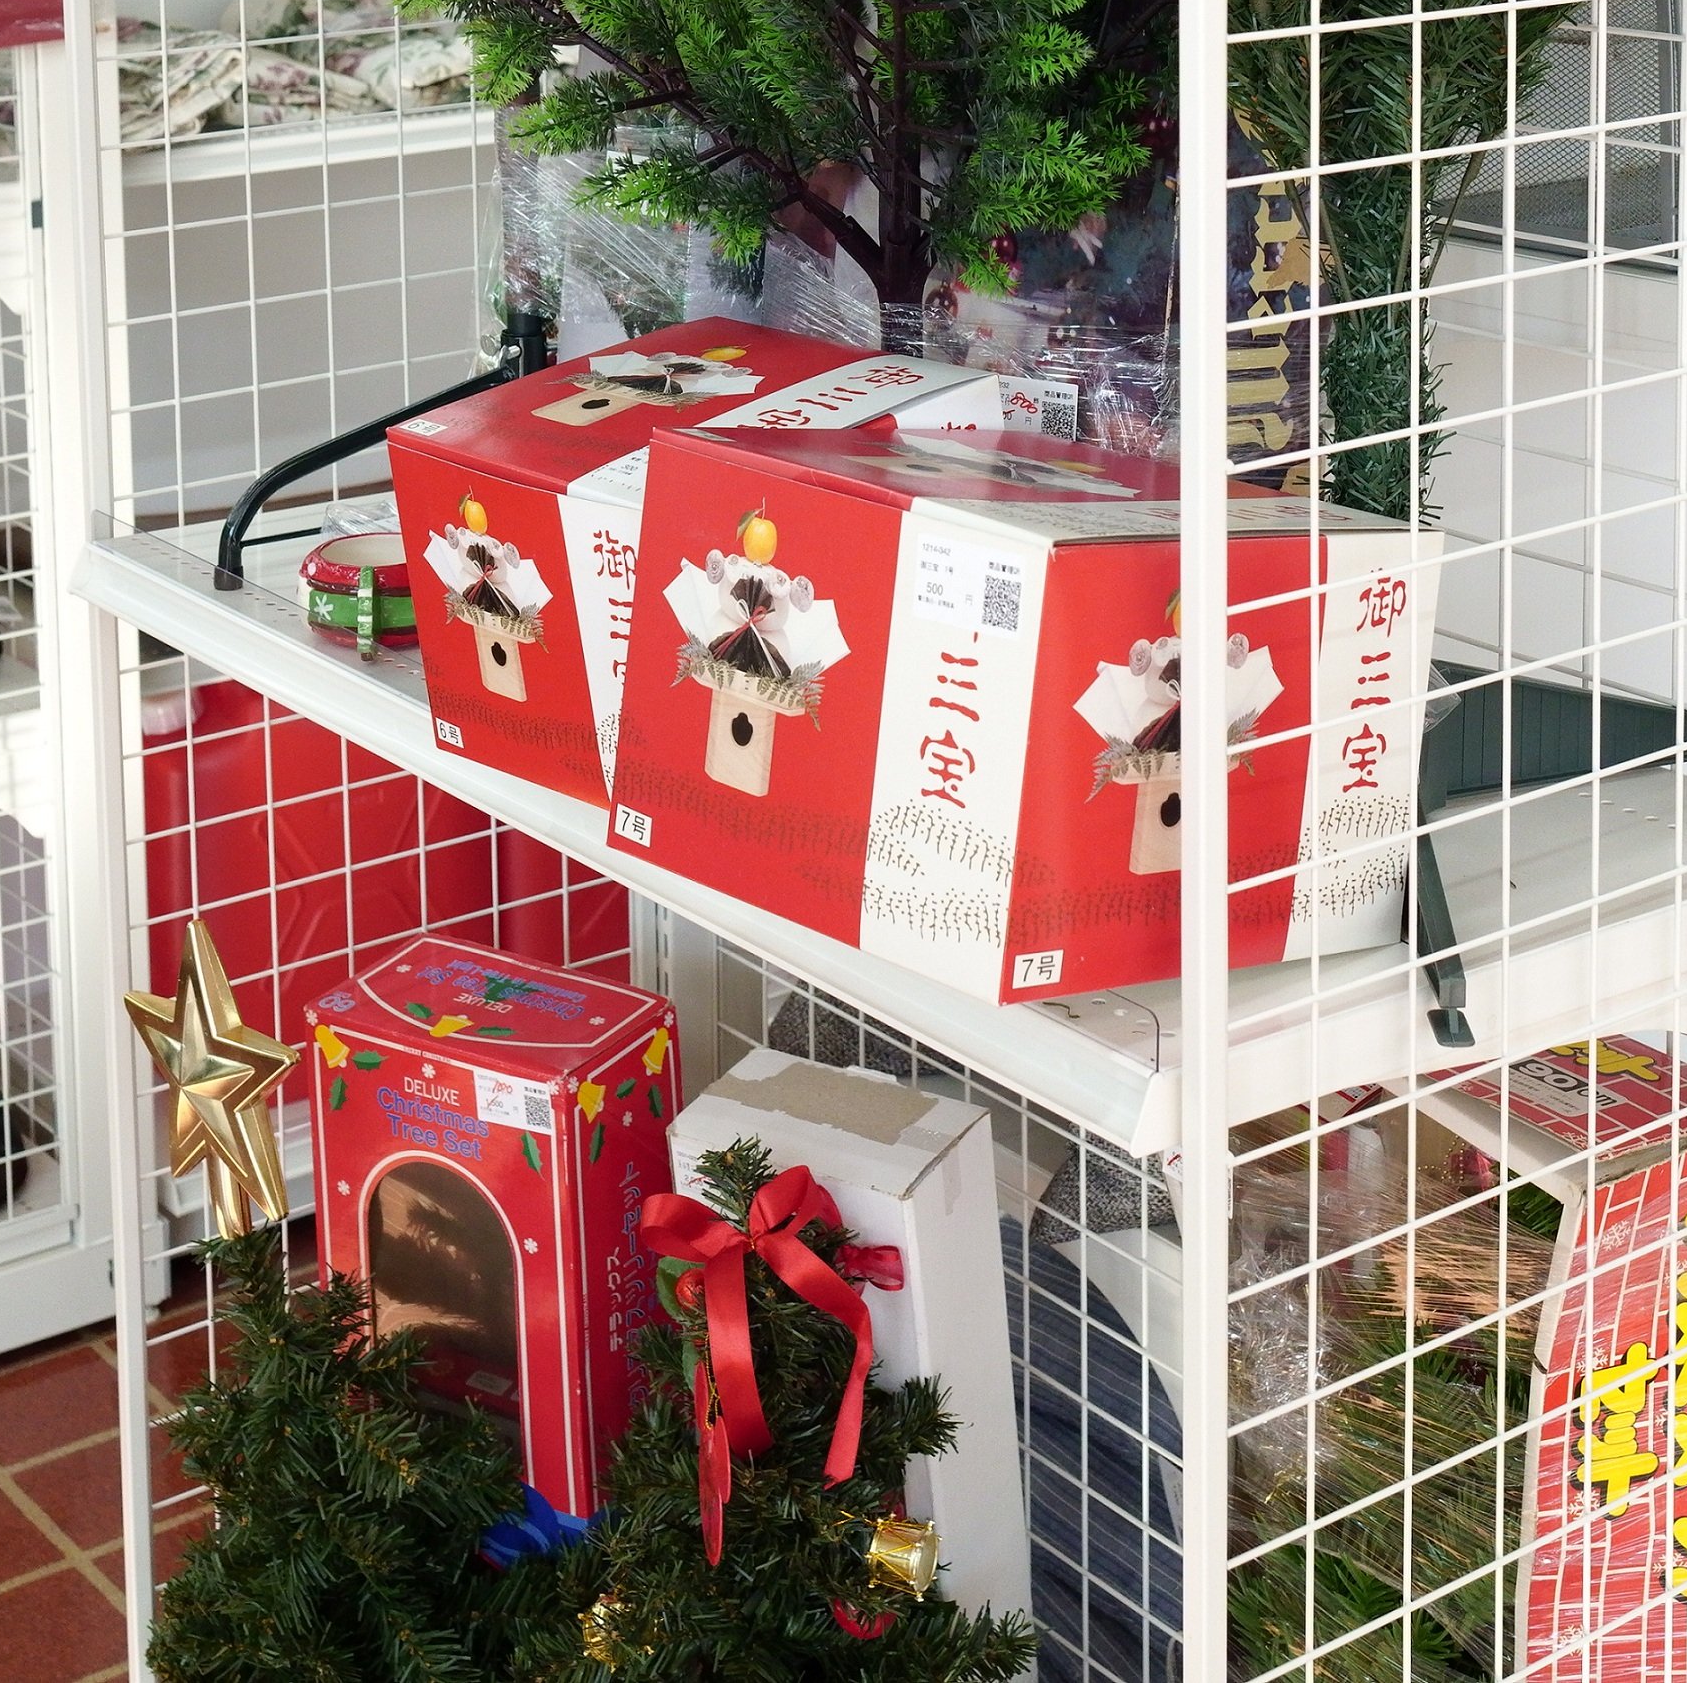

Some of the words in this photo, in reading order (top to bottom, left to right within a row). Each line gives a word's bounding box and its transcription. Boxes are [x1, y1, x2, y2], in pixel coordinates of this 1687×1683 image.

[926, 581, 944, 596] 500
[1341, 569, 1407, 794] 御三宝
[437, 722, 462, 745] 6号
[620, 809, 647, 843] 7号
[1021, 954, 1056, 983] 7号
[453, 992, 513, 1014] DELUXE
[403, 1076, 461, 1107] DELUXE
[377, 1086, 490, 1138] Christmas
[386, 1113, 438, 1148] Tree
[443, 1129, 483, 1162] Set
[606, 1246, 624, 1353] デラックス
[1576, 1341, 1660, 1519] セット
